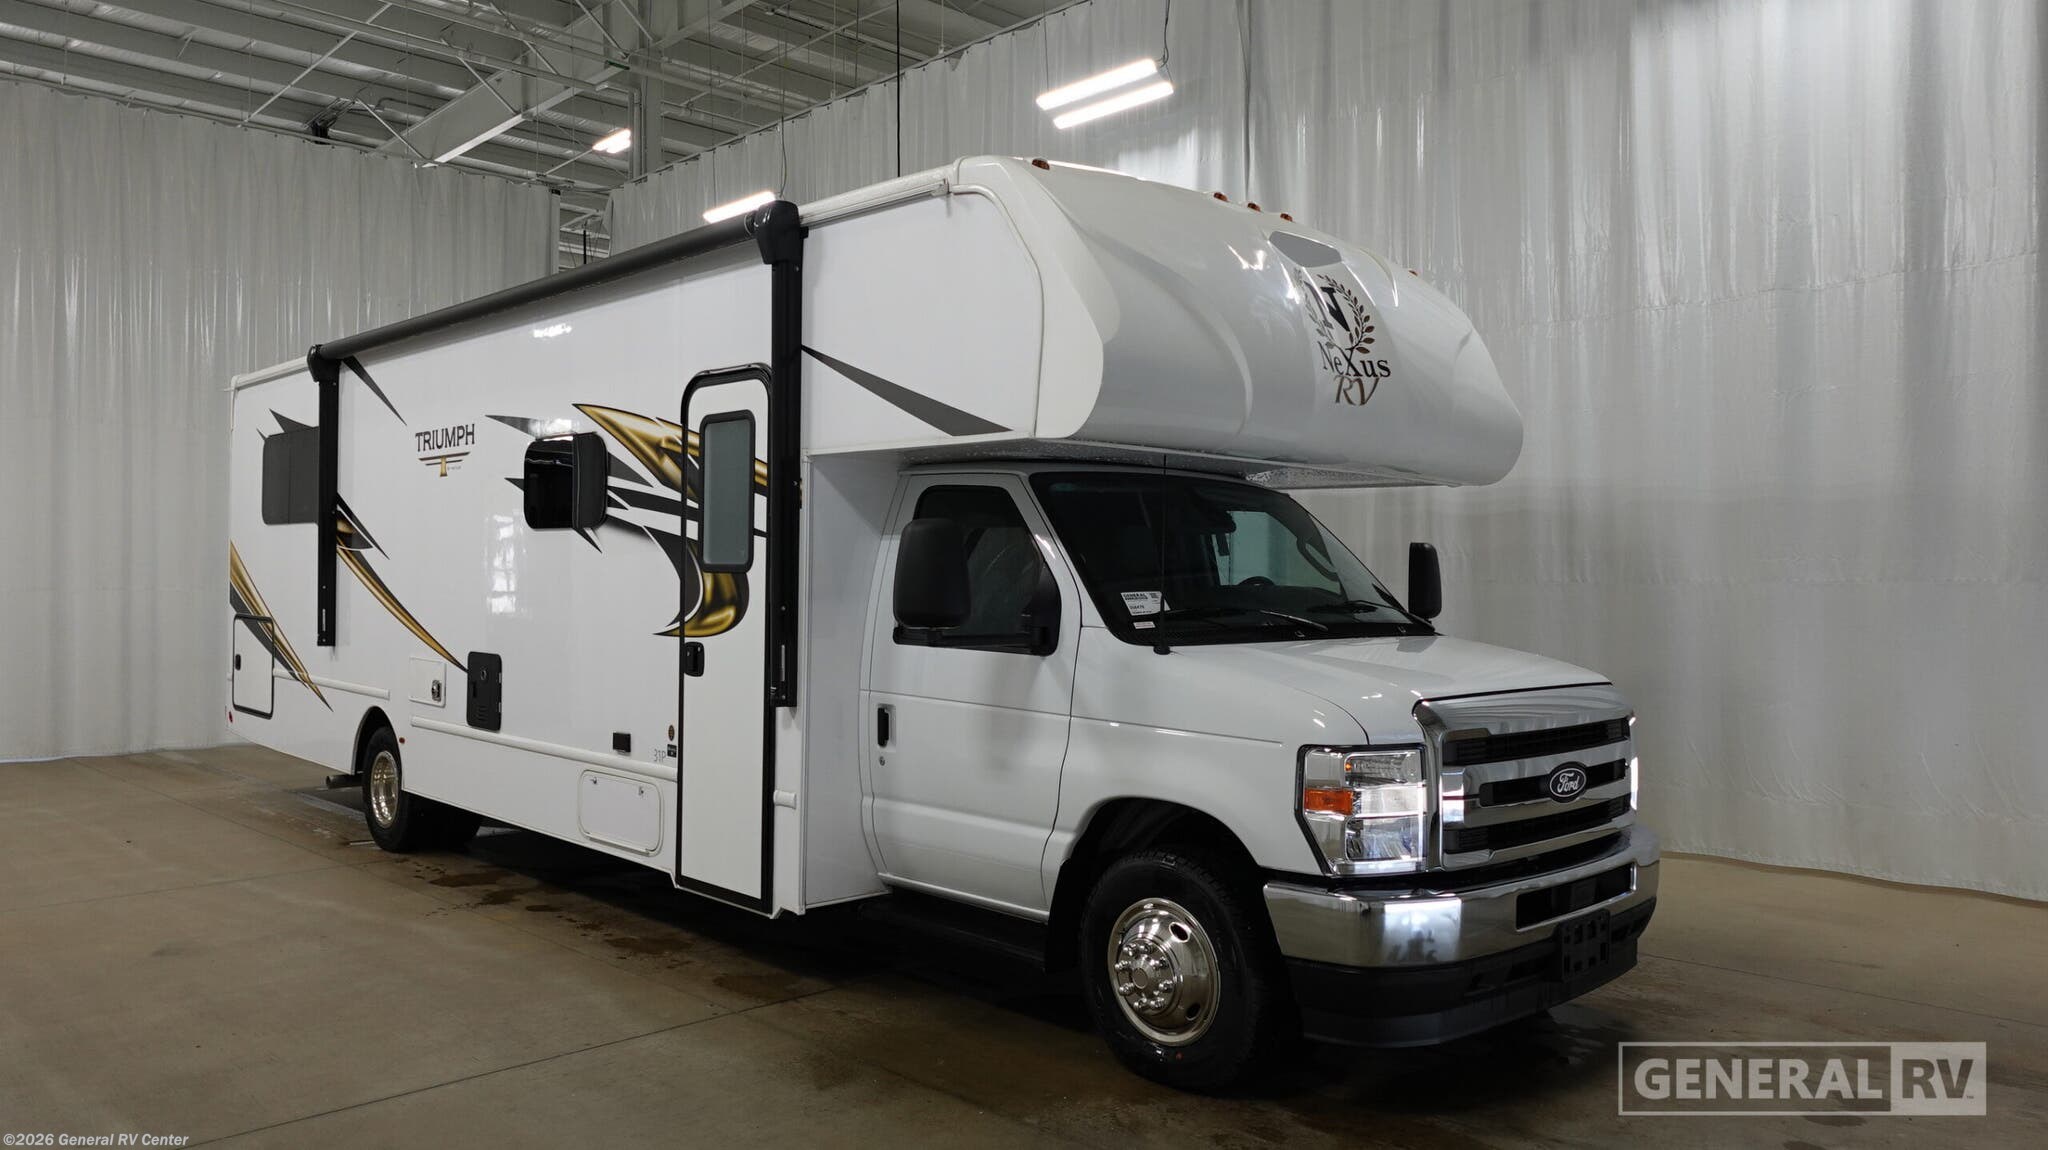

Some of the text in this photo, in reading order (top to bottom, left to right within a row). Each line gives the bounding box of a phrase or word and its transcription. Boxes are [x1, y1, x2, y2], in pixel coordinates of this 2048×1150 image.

[1317, 340, 1391, 378] NeXus
[1334, 375, 1380, 406] RV
[415, 423, 475, 452] TRIUMPH
[1557, 772, 1579, 792] Ford
